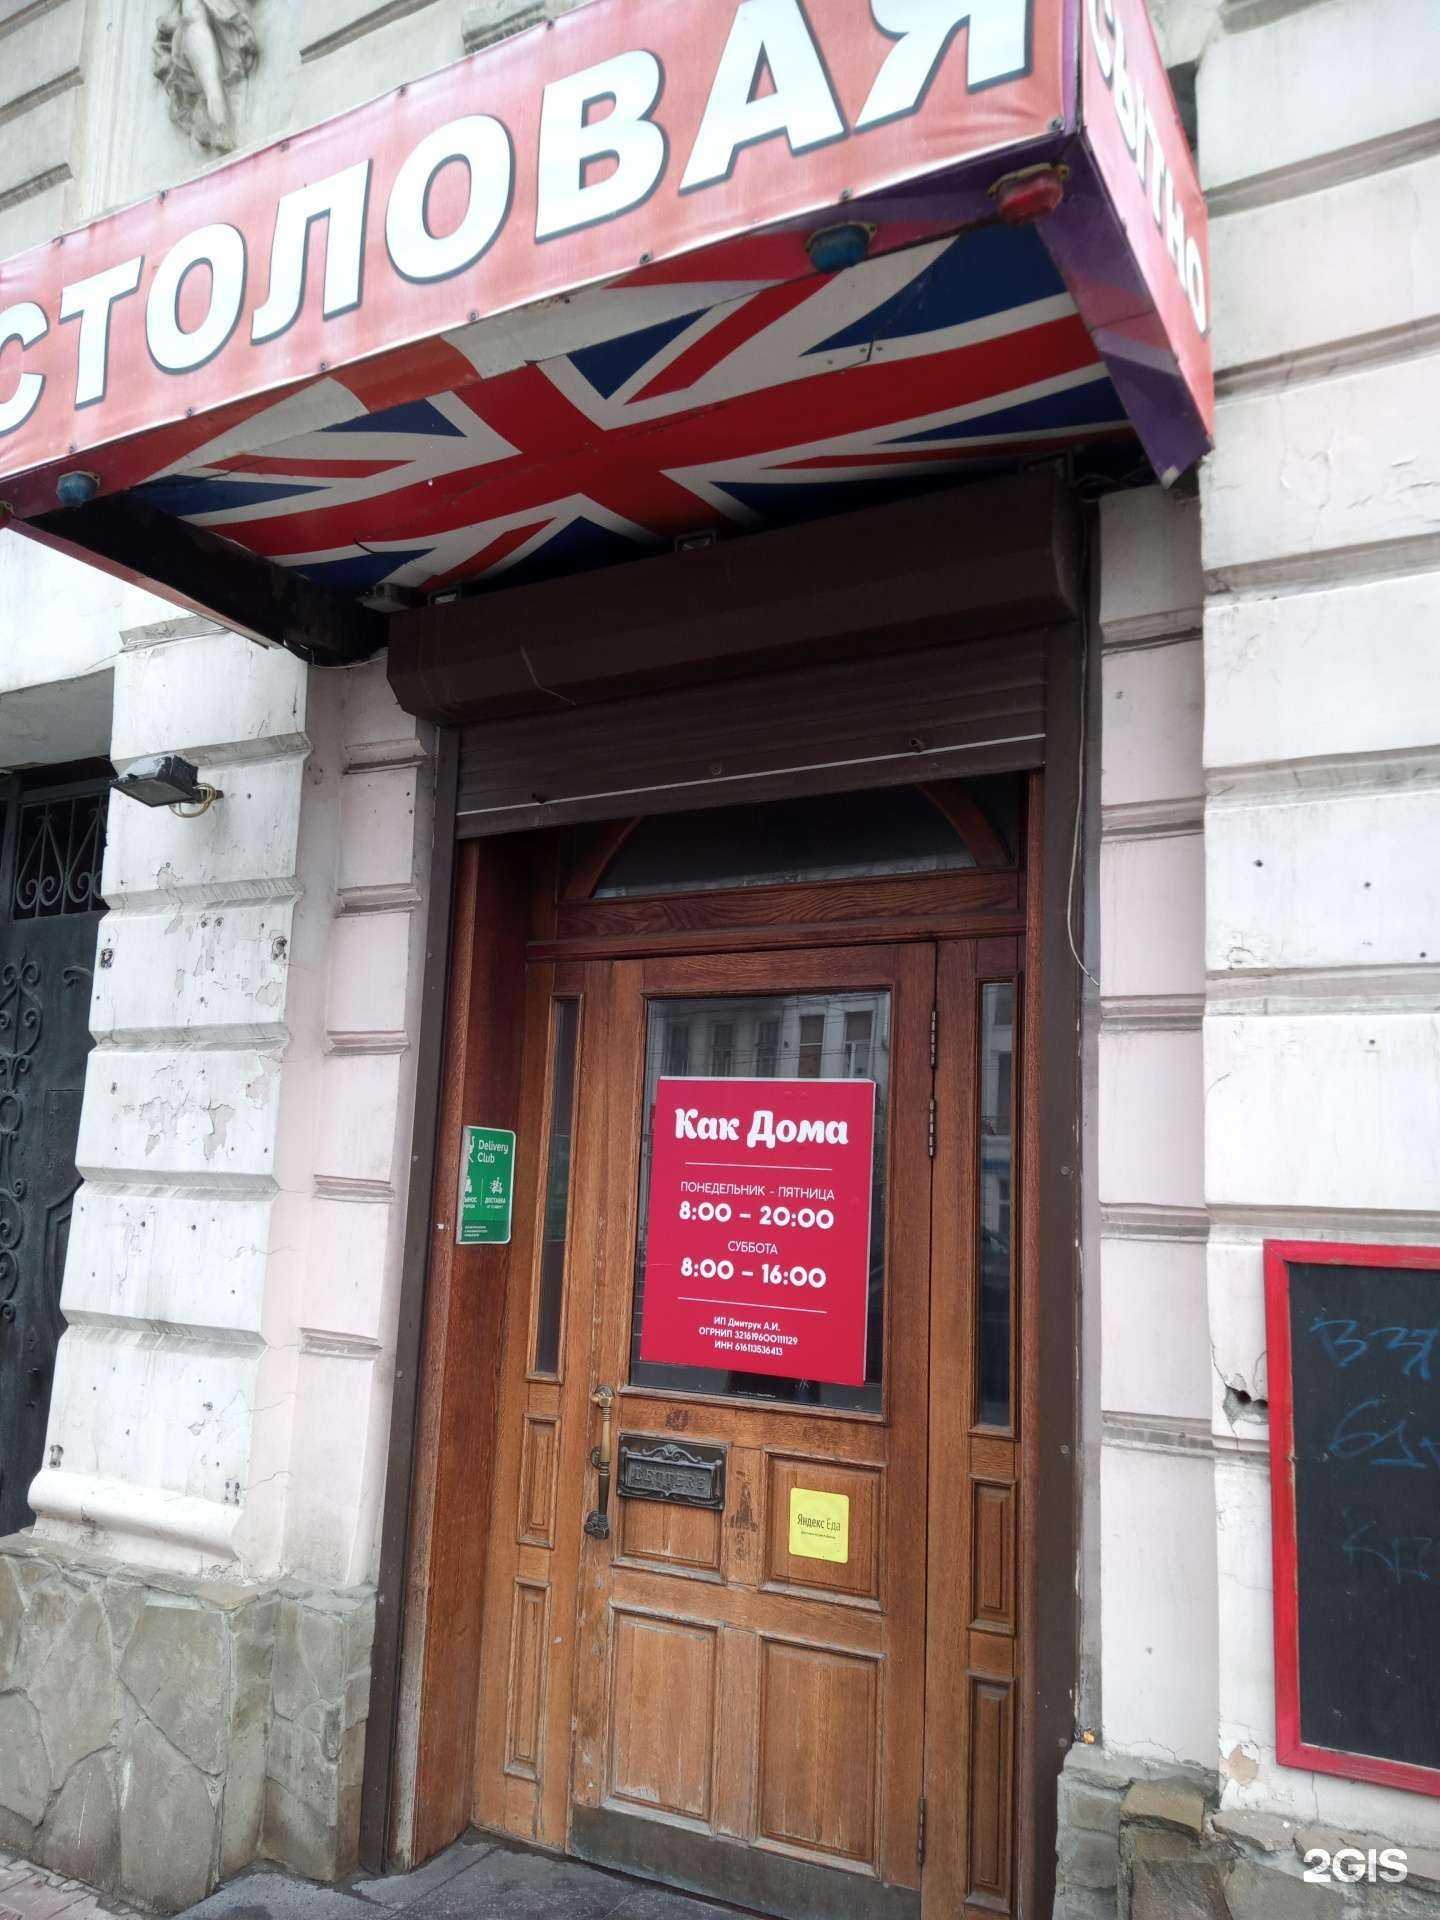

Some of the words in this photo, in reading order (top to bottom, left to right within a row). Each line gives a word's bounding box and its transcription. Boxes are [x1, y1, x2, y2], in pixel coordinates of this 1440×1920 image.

[675, 1108, 740, 1141] Как
[747, 1110, 848, 1149] Дома
[478, 1139, 509, 1155] Delivery
[477, 1152, 496, 1164] Club
[680, 1181, 766, 1196] ПОНЕДЕЛЬНИК
[778, 1187, 835, 1201] ПЯТНИЦА
[678, 1201, 732, 1222] 8:00
[759, 1205, 835, 1230] 20:00
[727, 1240, 779, 1255] СУББОТА
[680, 1257, 734, 1280] 8:00
[761, 1263, 827, 1289] 16:00
[713, 1316, 727, 1325] ИП
[727, 1318, 762, 1330] Дмитрук
[763, 1321, 781, 1331] А.И.
[698, 1326, 733, 1338] ОГРНИП
[734, 1331, 799, 1345] 321619600111129
[714, 1340, 734, 1350] ИНН
[734, 1343, 784, 1356] 616113536413
[797, 1513, 825, 1529] Яндекс
[826, 1518, 841, 1532] Еда
